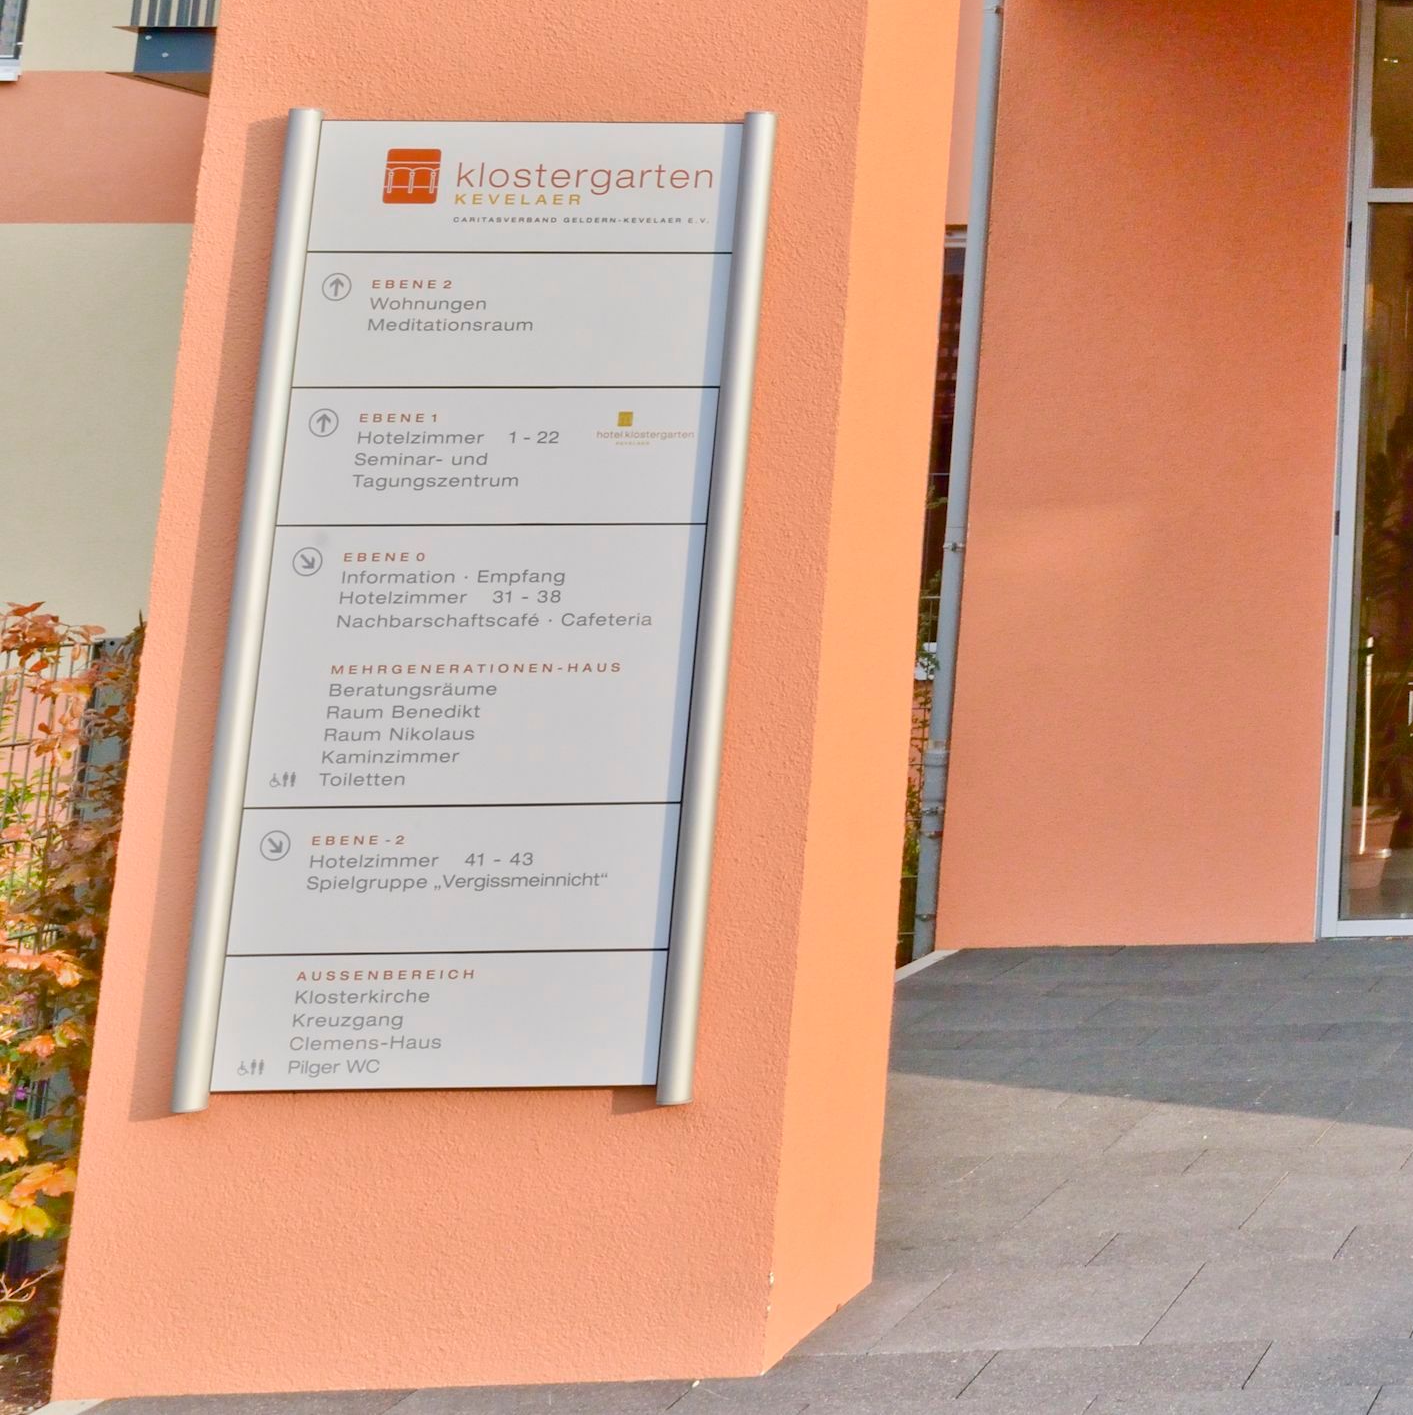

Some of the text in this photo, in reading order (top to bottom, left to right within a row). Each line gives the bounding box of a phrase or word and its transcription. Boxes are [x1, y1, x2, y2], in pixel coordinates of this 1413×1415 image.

[456, 161, 714, 196] klostergarten
[455, 194, 580, 205] KEVELAER
[453, 216, 557, 224] CARITASVERBAND
[563, 216, 682, 224] GELDERN-KEVELAER
[372, 280, 452, 289] EBENE 2
[370, 297, 486, 313] Wohnungen
[368, 319, 533, 331] Meditationsraum
[360, 414, 437, 422] EBENE 1
[358, 431, 484, 444] Hotelzimmer
[537, 431, 559, 444] 22
[355, 453, 488, 466] Seminar- und
[353, 475, 518, 491] Tagungszentrum
[344, 553, 409, 562] EBENE
[342, 571, 455, 584] Information
[478, 569, 565, 586] Empfang
[340, 591, 467, 604] Hotelzimmer
[493, 590, 511, 603] 31
[537, 590, 561, 603] 38
[337, 613, 539, 628] Nachbarschaftscafé
[562, 613, 652, 626] Cafeteria
[331, 663, 620, 674] MEHRGENERATIONEN-HAUS
[329, 683, 497, 700] Beratungsräume
[327, 705, 480, 719] Raum Benedikt
[324, 727, 474, 741] Raum Nikolaus
[322, 750, 460, 764] Kaminzimmer
[320, 773, 405, 786] Toiletten
[312, 835, 378, 845] EBENE
[310, 854, 439, 868] Hotelzimmer
[465, 853, 484, 866] 41
[510, 852, 533, 866] 43
[307, 876, 427, 893] Spielgruppe
[297, 969, 474, 981] AUSSENBEREICH
[295, 989, 430, 1004] Klosterkirche
[293, 1014, 403, 1030] Kreuzgang
[290, 1035, 441, 1051] Clemens-Haus
[288, 1059, 380, 1077] Pilger WC
